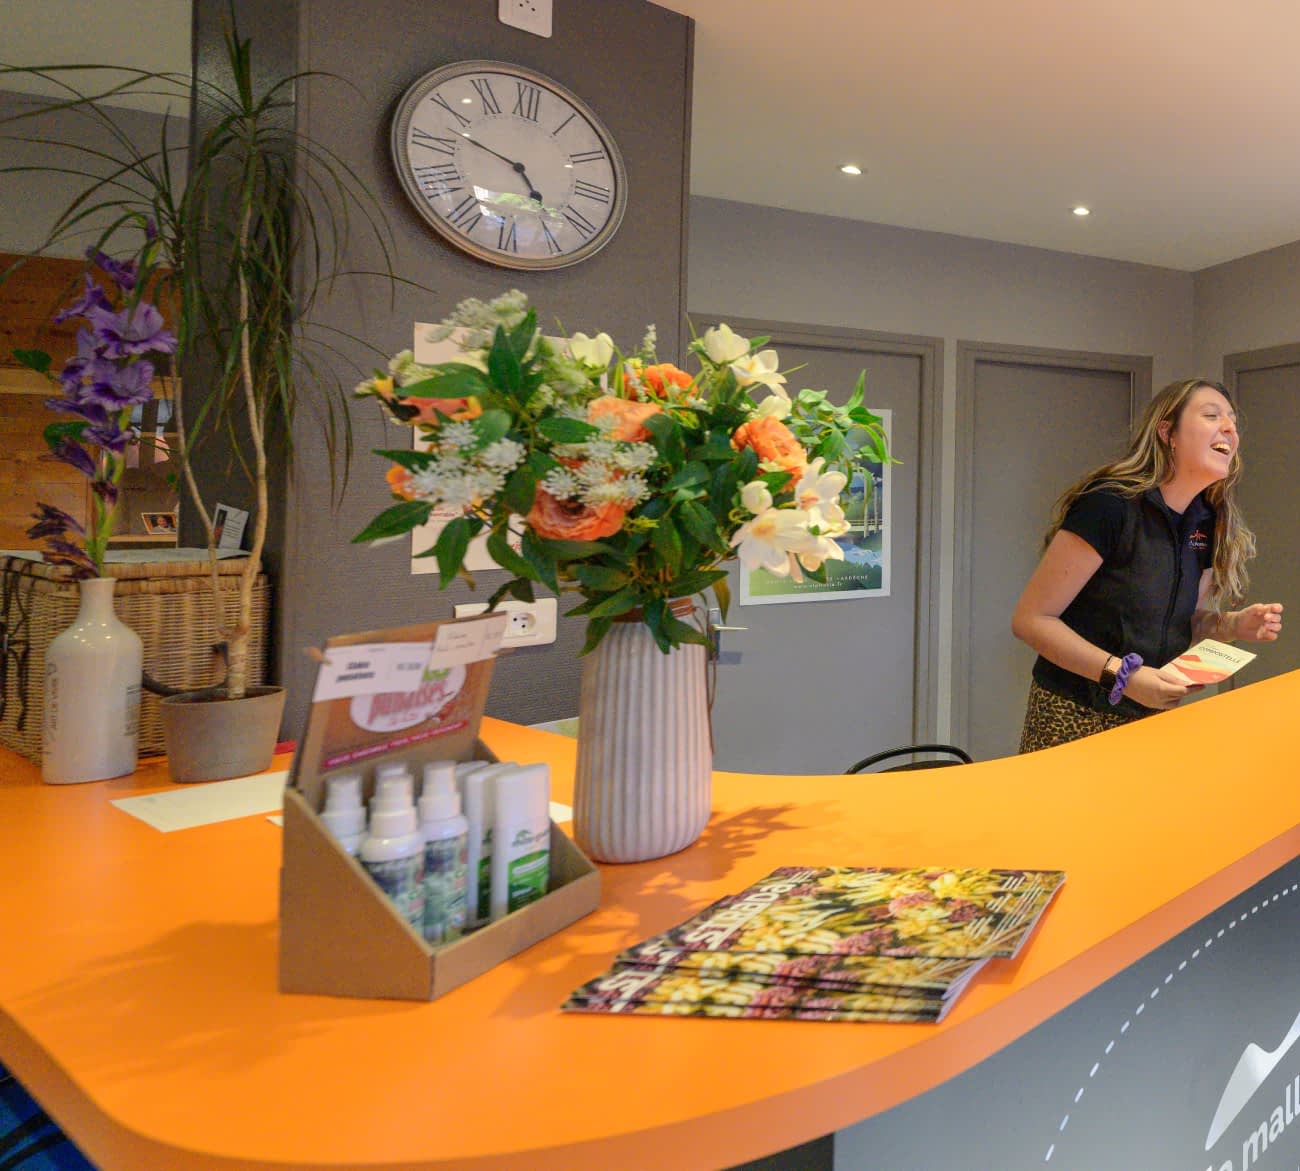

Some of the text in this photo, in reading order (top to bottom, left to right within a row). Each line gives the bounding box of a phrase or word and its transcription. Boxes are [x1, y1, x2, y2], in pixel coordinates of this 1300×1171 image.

[430, 93, 471, 128] X
[469, 78, 503, 116] XI
[512, 81, 542, 123] XII
[568, 149, 606, 165] II
[574, 178, 611, 205] III
